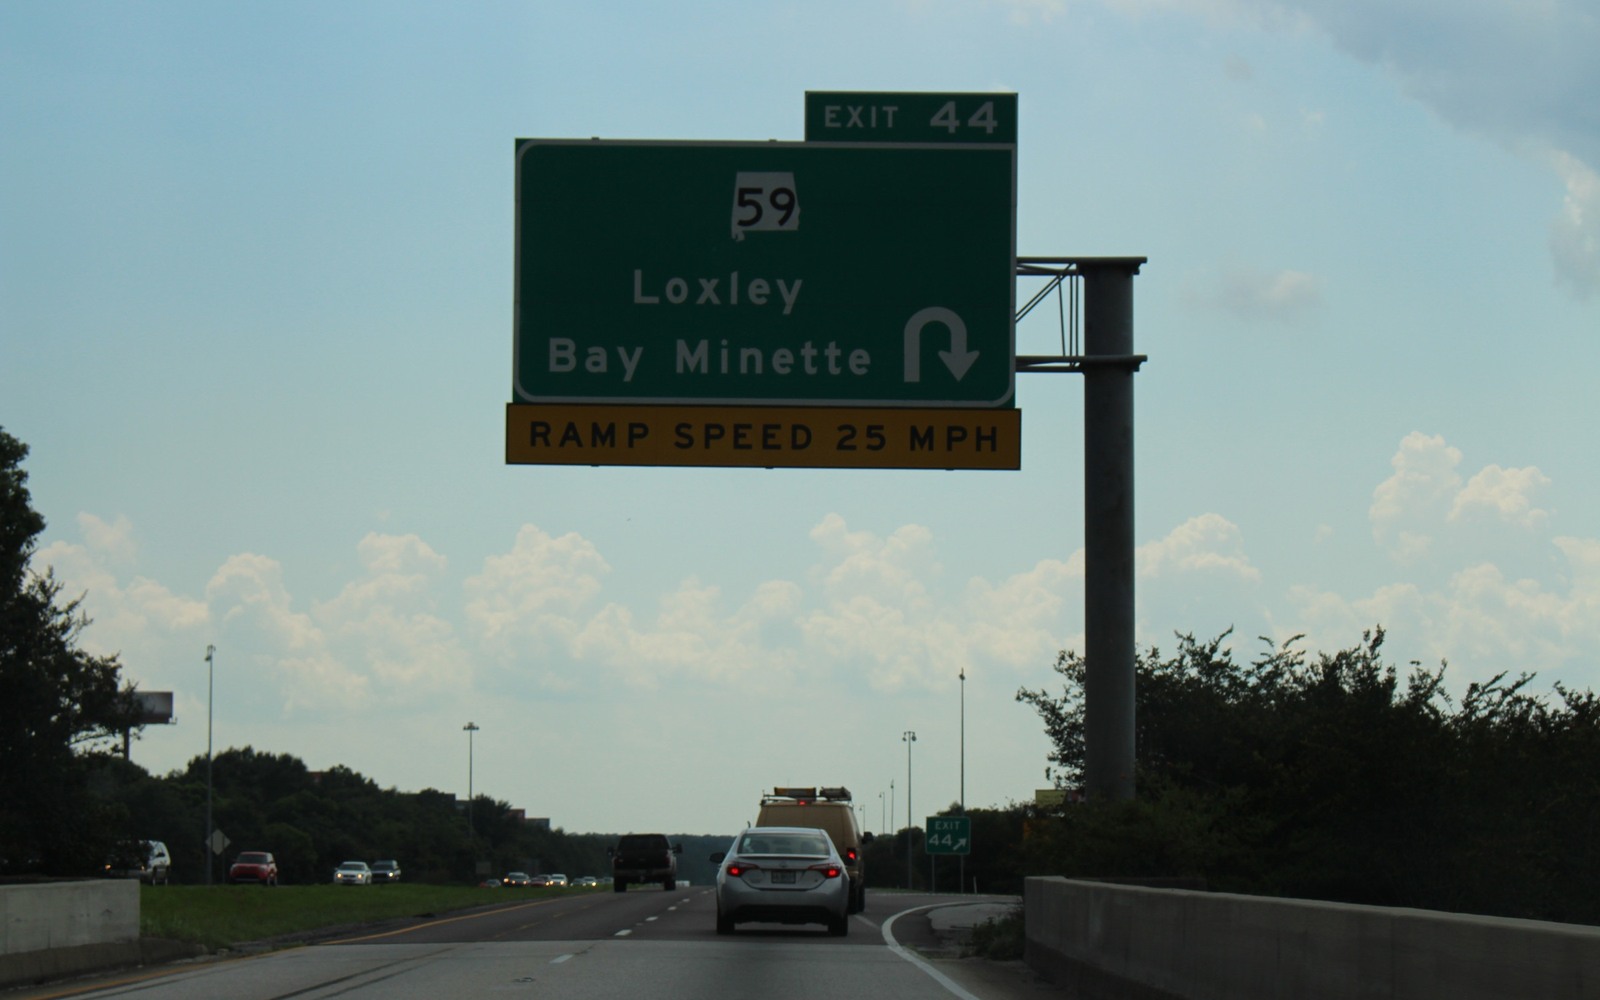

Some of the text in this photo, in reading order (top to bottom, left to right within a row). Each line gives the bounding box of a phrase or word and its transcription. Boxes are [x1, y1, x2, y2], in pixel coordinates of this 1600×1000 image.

[824, 100, 998, 134] EXIT 44
[737, 187, 796, 227] 59
[633, 268, 803, 315] Loxley
[548, 337, 871, 382] Bay Minette
[529, 420, 998, 453] RAMP SPEED 25 MPH
[928, 833, 953, 846] 44
[935, 820, 961, 831] EXIT
